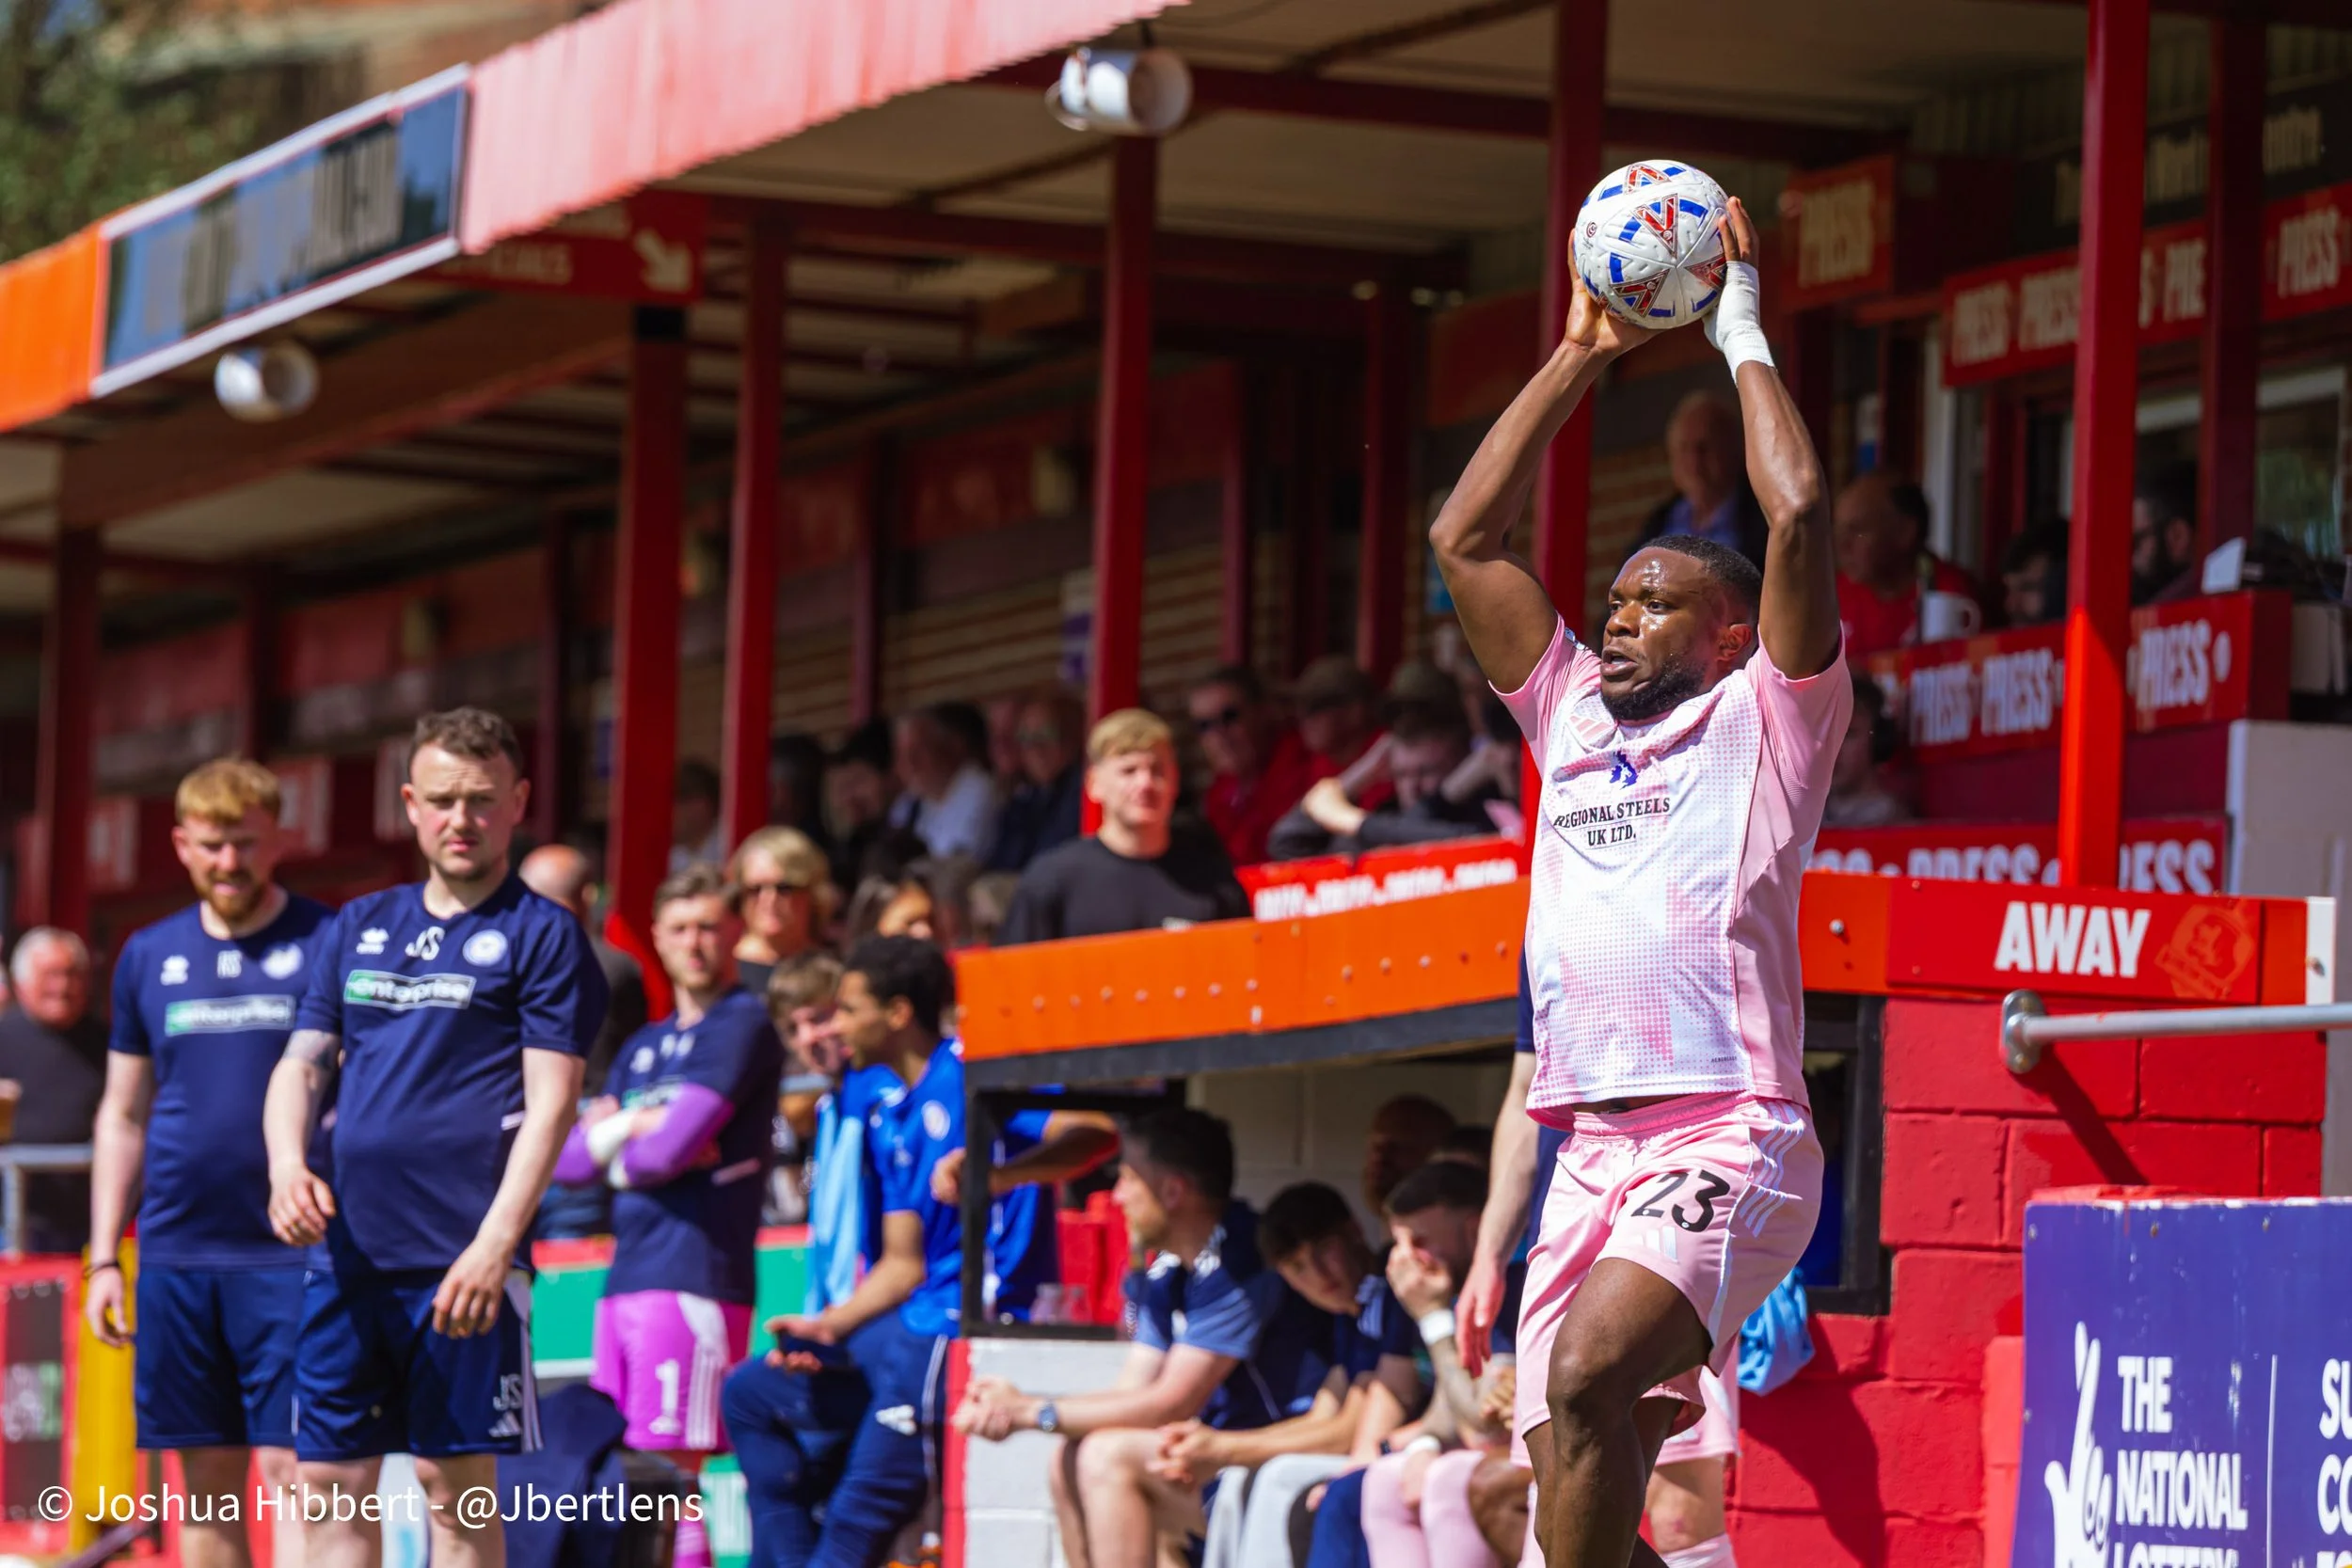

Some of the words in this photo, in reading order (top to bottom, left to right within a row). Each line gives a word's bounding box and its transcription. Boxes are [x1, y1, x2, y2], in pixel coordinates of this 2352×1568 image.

[2278, 207, 2339, 298] PRESS
[1953, 281, 2011, 368] PRESS
[2165, 244, 2206, 323] PRE
[1910, 661, 1973, 746] PRESS
[1980, 646, 2054, 737] PRESS
[2137, 618, 2211, 711] PRESS
[1553, 805, 1614, 828] REGIONAL
[1616, 797, 1671, 819] STEELS
[1587, 829, 1607, 847] UK
[1611, 824, 1637, 844] LTD.
[2119, 839, 2215, 896] ESS
[405, 926, 445, 960] JS
[1993, 900, 2153, 978] AWAY
[1630, 1168, 1731, 1233] 23
[653, 1358, 680, 1426] 1
[2118, 1356, 2172, 1433] THE
[2116, 1449, 2249, 1530] NATIONAL
